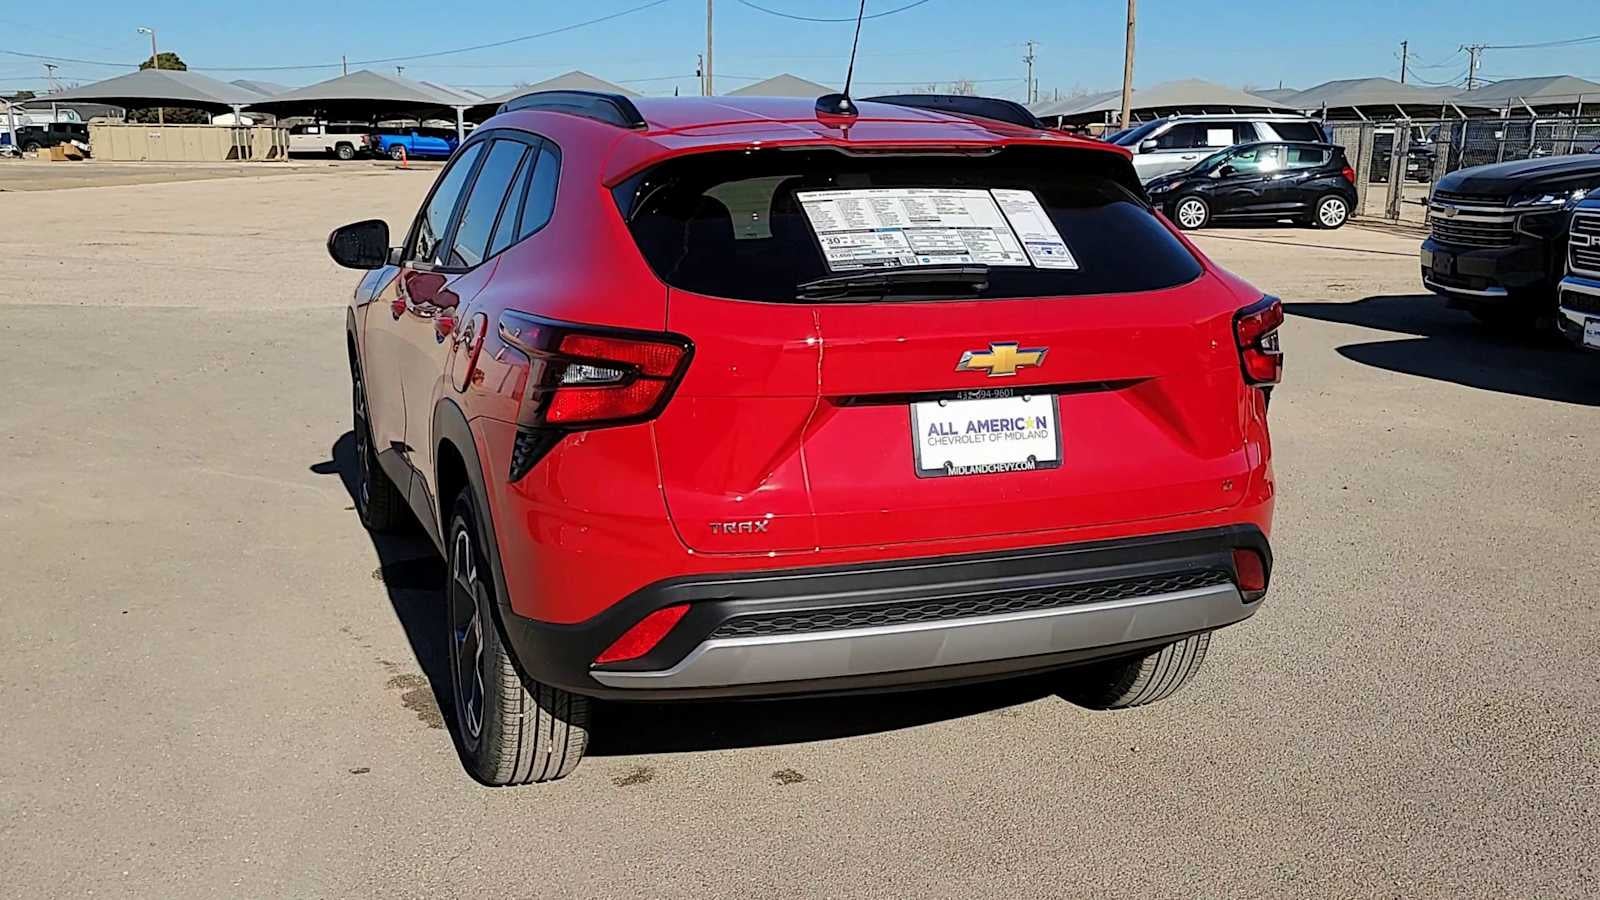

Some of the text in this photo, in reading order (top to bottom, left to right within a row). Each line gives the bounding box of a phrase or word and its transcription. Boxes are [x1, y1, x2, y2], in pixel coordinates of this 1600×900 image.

[927, 421, 959, 437] ALL
[927, 429, 1049, 447] CHEVROLET OF MIDLAND
[947, 460, 1036, 476] MIDLANDCHEVY.COM
[708, 520, 769, 534] TRAX
